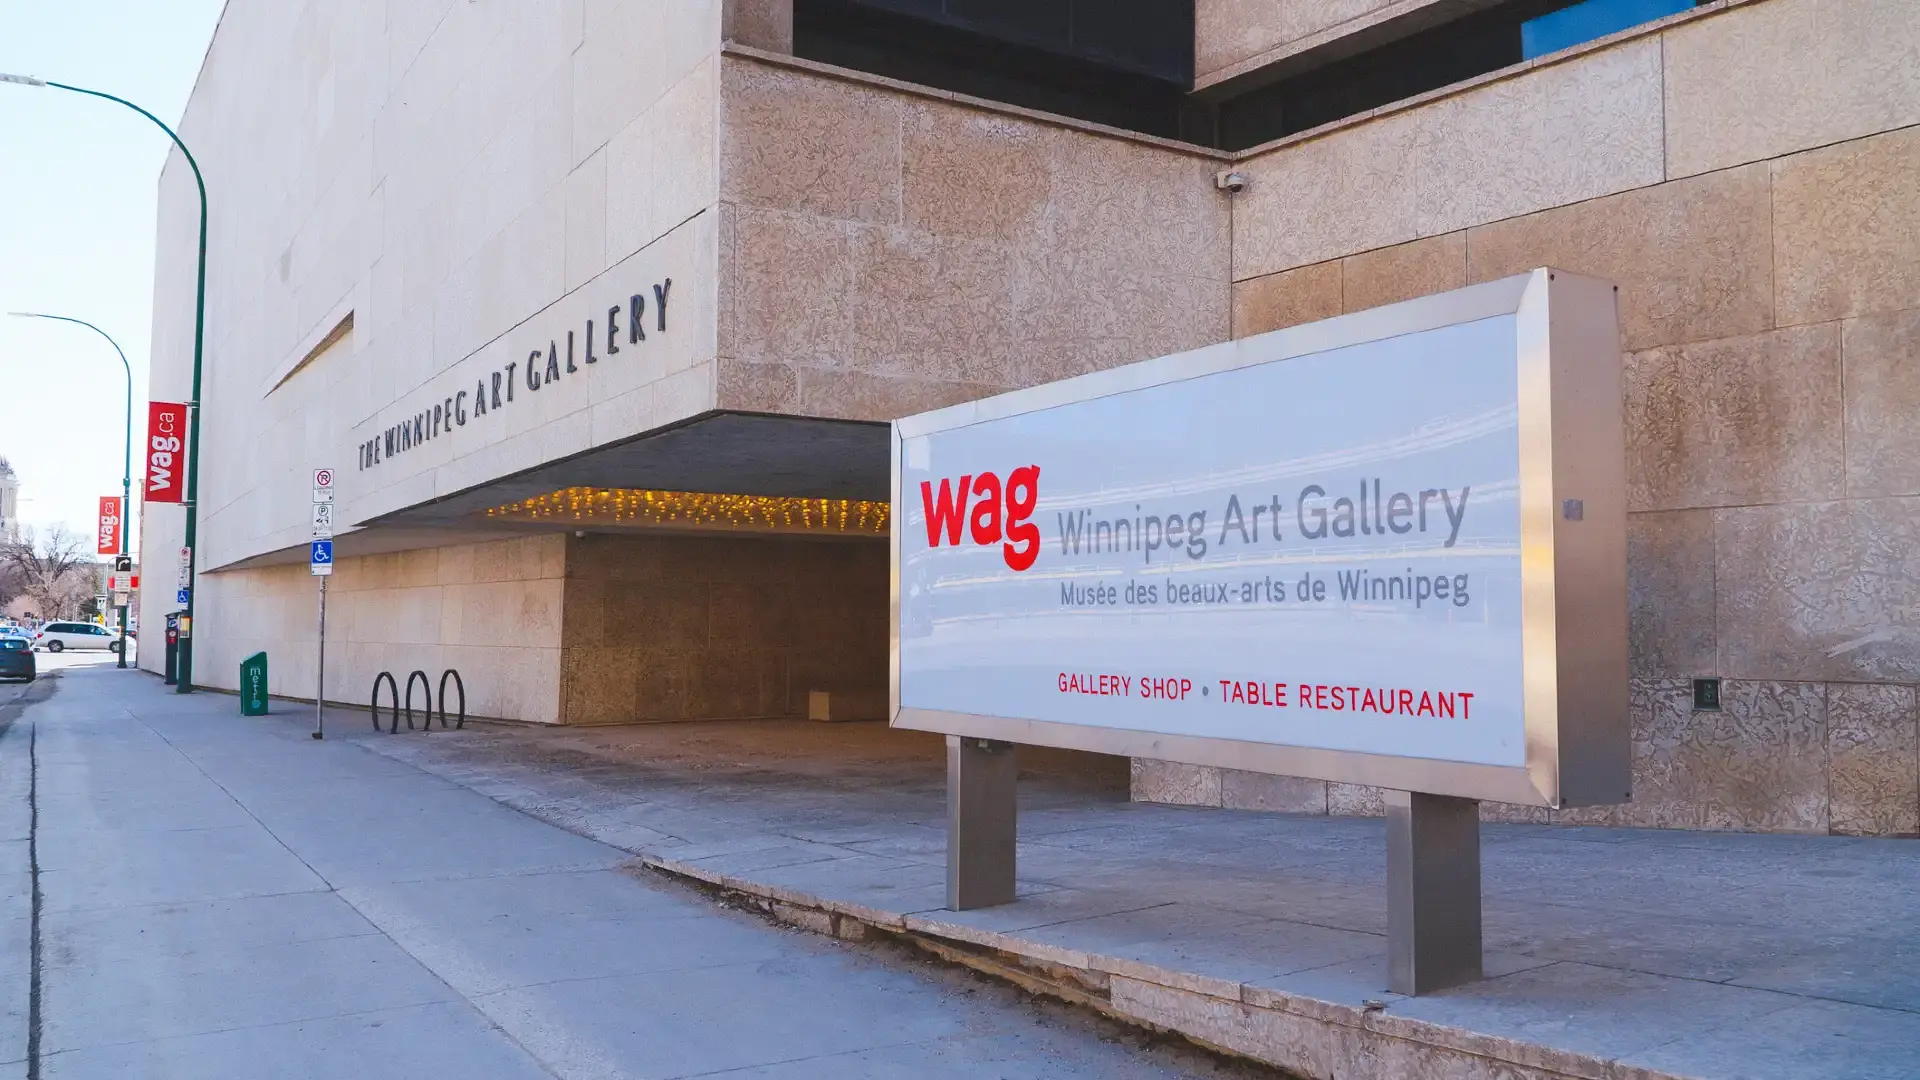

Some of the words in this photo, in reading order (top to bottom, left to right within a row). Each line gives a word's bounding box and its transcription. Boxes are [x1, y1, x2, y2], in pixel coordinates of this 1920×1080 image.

[358, 434, 381, 472] THE
[384, 389, 467, 459] WINNIPEG
[474, 361, 516, 418] ART
[525, 277, 672, 392] GALLERY
[149, 411, 180, 492] wag.ca
[920, 464, 1041, 571] wag
[1057, 504, 1208, 564] Winnipeg
[1218, 492, 1282, 546] Art
[1296, 477, 1471, 548] Gallery
[1060, 580, 1118, 606] Musée
[1124, 577, 1159, 604] des
[1166, 573, 1287, 604] beaux-arts
[1296, 571, 1327, 602] de
[1337, 566, 1470, 609] Winnipeg
[1057, 671, 1132, 698] GALLERY
[1140, 678, 1193, 701] SHOP
[1219, 679, 1288, 707] TABLE
[1300, 684, 1475, 720] RESTAURANT
